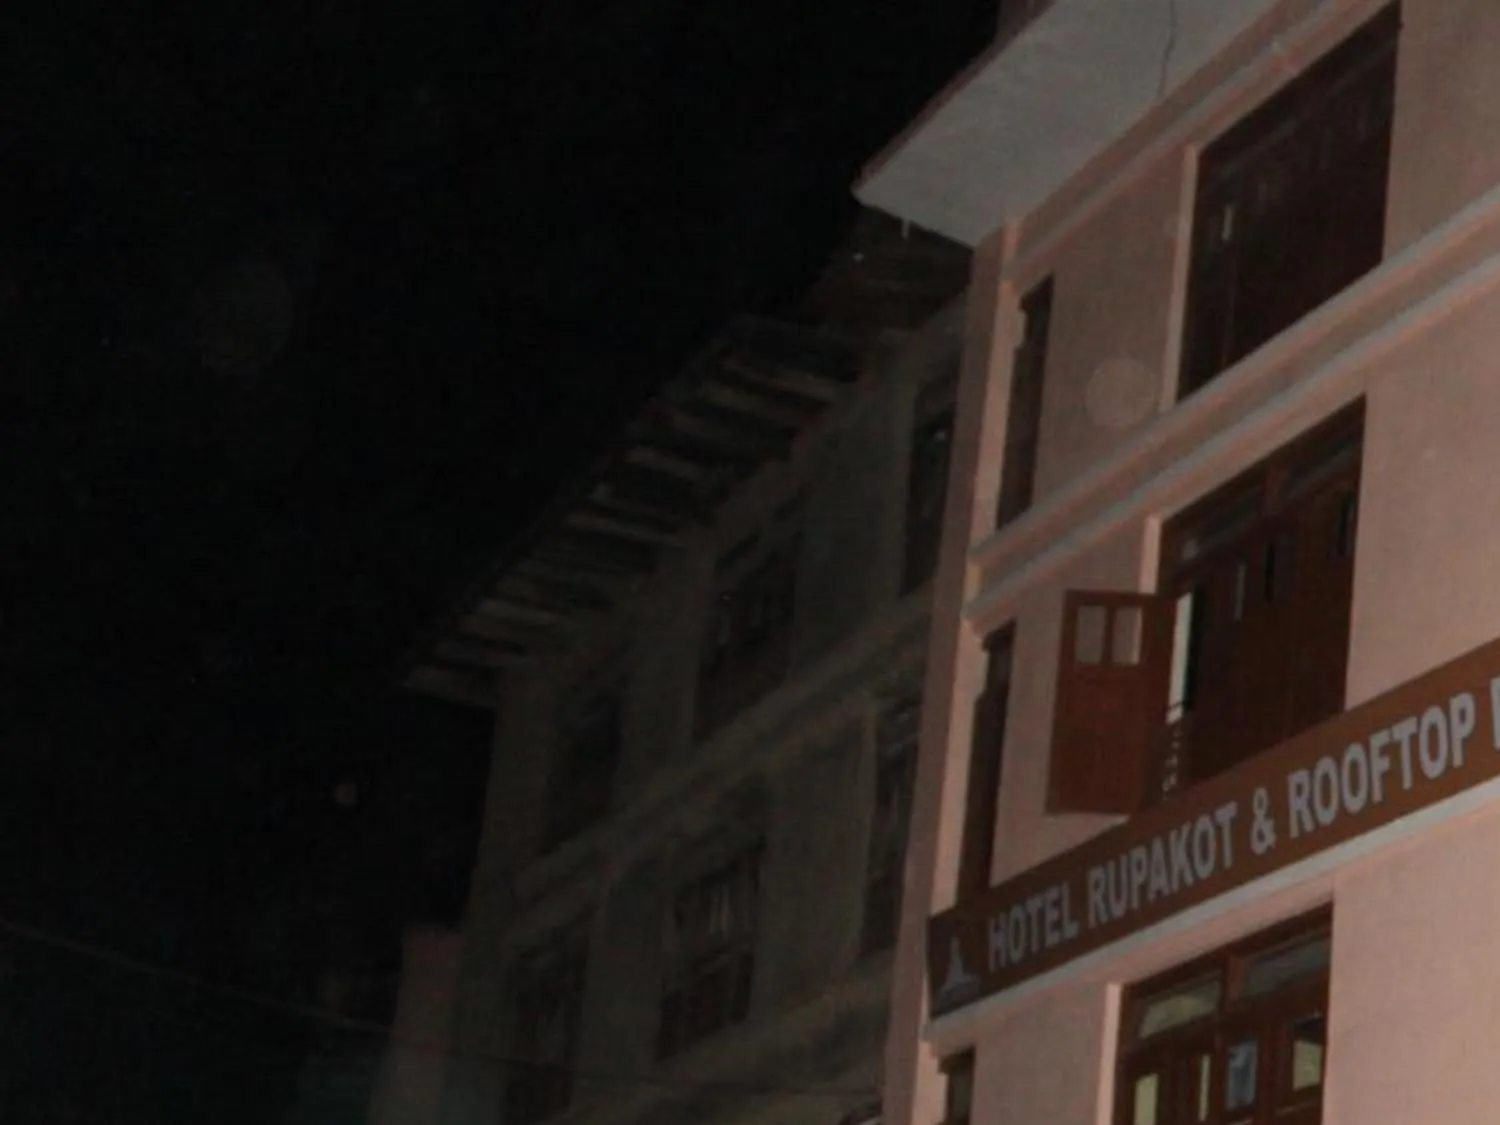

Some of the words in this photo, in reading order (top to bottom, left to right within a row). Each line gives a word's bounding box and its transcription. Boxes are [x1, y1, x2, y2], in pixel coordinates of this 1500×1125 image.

[988, 881, 1079, 973] HOTEL
[1087, 800, 1239, 929] RUPAKOT
[1251, 786, 1277, 856] &
[1287, 692, 1476, 839] ROOFTOP
